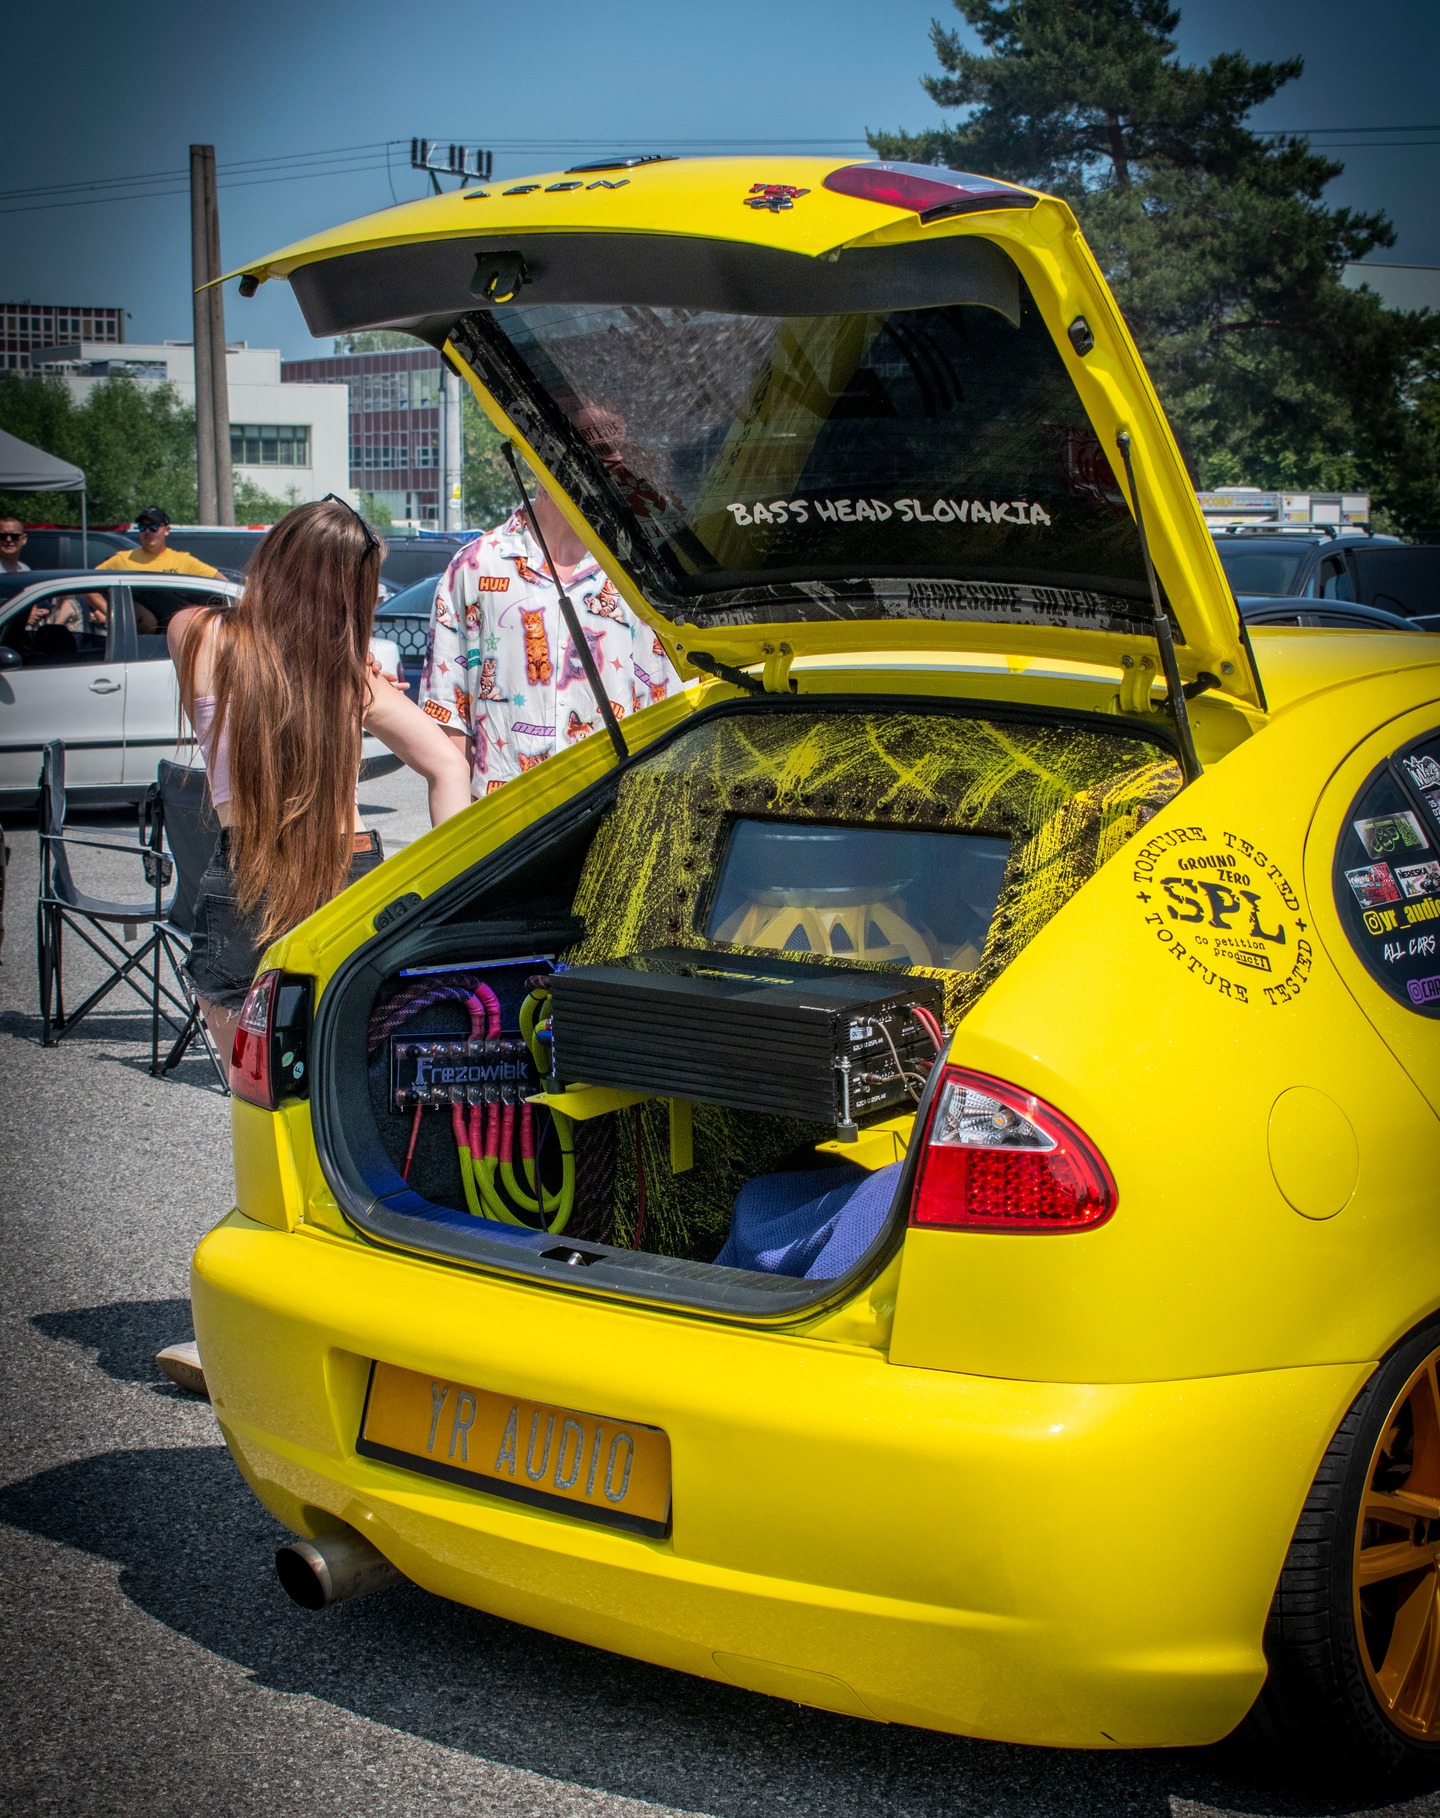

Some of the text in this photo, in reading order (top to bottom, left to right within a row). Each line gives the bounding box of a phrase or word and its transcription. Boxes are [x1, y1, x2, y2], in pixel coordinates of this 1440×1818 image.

[463, 179, 630, 201] LEON
[727, 499, 1051, 526] BASS HEAD SLOVAKIA
[479, 576, 510, 592] HUH
[1031, 587, 1099, 620] SILVER
[424, 700, 452, 723] HUH
[1133, 827, 1207, 883] TORTURE
[1222, 831, 1300, 911] TESTED
[1178, 854, 1236, 870] GROUND
[1217, 869, 1251, 886] ZERO
[1160, 876, 1286, 945] SPL
[1145, 912, 1312, 1006] TORTURE TESTED
[1384, 934, 1436, 963] ALL CARS
[416, 1057, 529, 1084] Frezowiak
[427, 1382, 635, 1503] YR AUDIO
